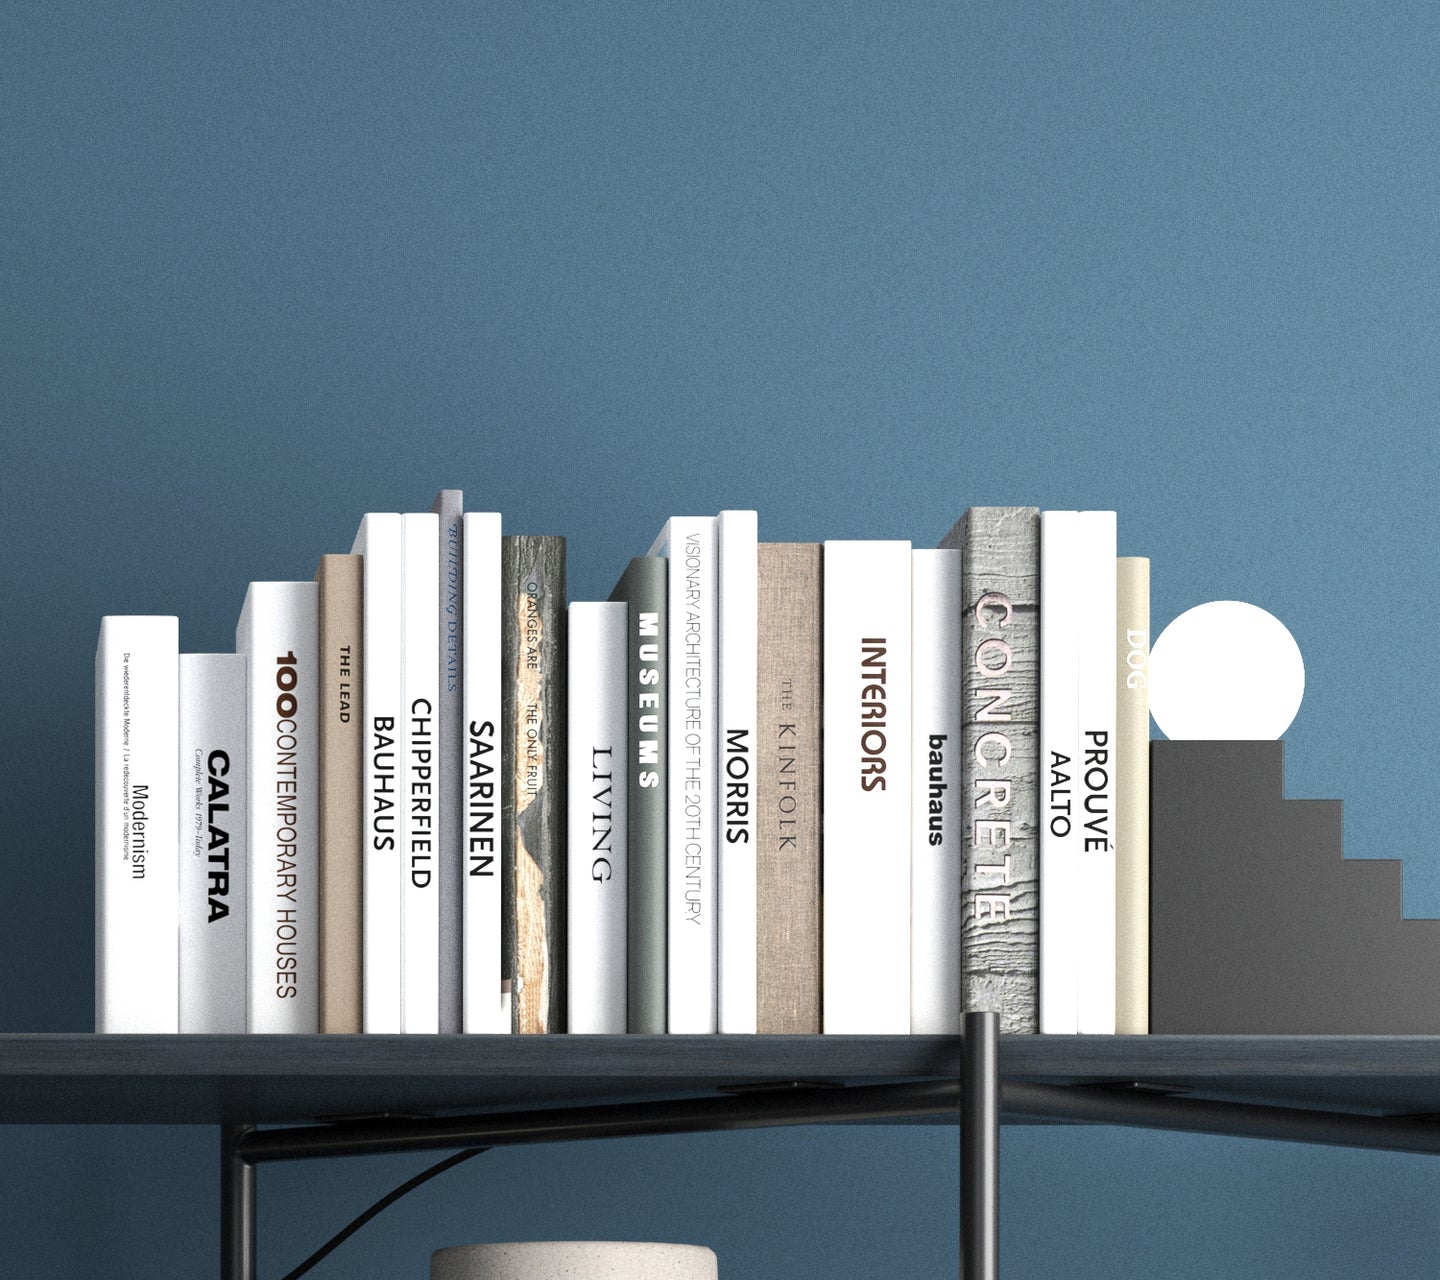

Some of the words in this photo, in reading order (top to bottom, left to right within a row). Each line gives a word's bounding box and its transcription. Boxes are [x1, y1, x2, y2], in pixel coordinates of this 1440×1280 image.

[446, 523, 458, 616] BUILDING
[685, 533, 701, 609] VISIONARY
[526, 582, 538, 643] ORANGES
[339, 645, 351, 677] THE
[447, 621, 457, 693] DETAILS
[526, 646, 538, 669] ARE
[685, 611, 701, 730] ARCHITECTURE
[781, 679, 792, 711] THE
[1126, 629, 1147, 689] DOG
[339, 684, 351, 724] LEAD
[526, 703, 537, 725] THE
[638, 611, 659, 789] MUSEUMS
[860, 638, 887, 791] INTERIORS
[193, 748, 203, 784] Complete
[373, 716, 395, 851] BAUHAUS
[526, 729, 537, 761] ONLY
[526, 765, 537, 798] FRUIT
[685, 733, 701, 754] OF
[685, 756, 701, 791] THE
[726, 729, 749, 843] MORRIS
[974, 592, 1013, 921] CONCRETE
[195, 787, 203, 809] Works
[411, 698, 432, 889] CHIPPERFIELD
[469, 720, 495, 877] SAARINEN
[591, 745, 613, 884] LIVING
[685, 794, 701, 839] 20TH
[778, 723, 797, 851] KINFOLK
[928, 734, 945, 847] bauhaus
[1050, 751, 1071, 838] AALTO
[1083, 730, 1114, 853] PROUVÉ
[132, 785, 149, 879] Modernism
[208, 750, 231, 923] CALATRA
[685, 843, 701, 926] CENTURY
[276, 908, 297, 999] HOUSES
